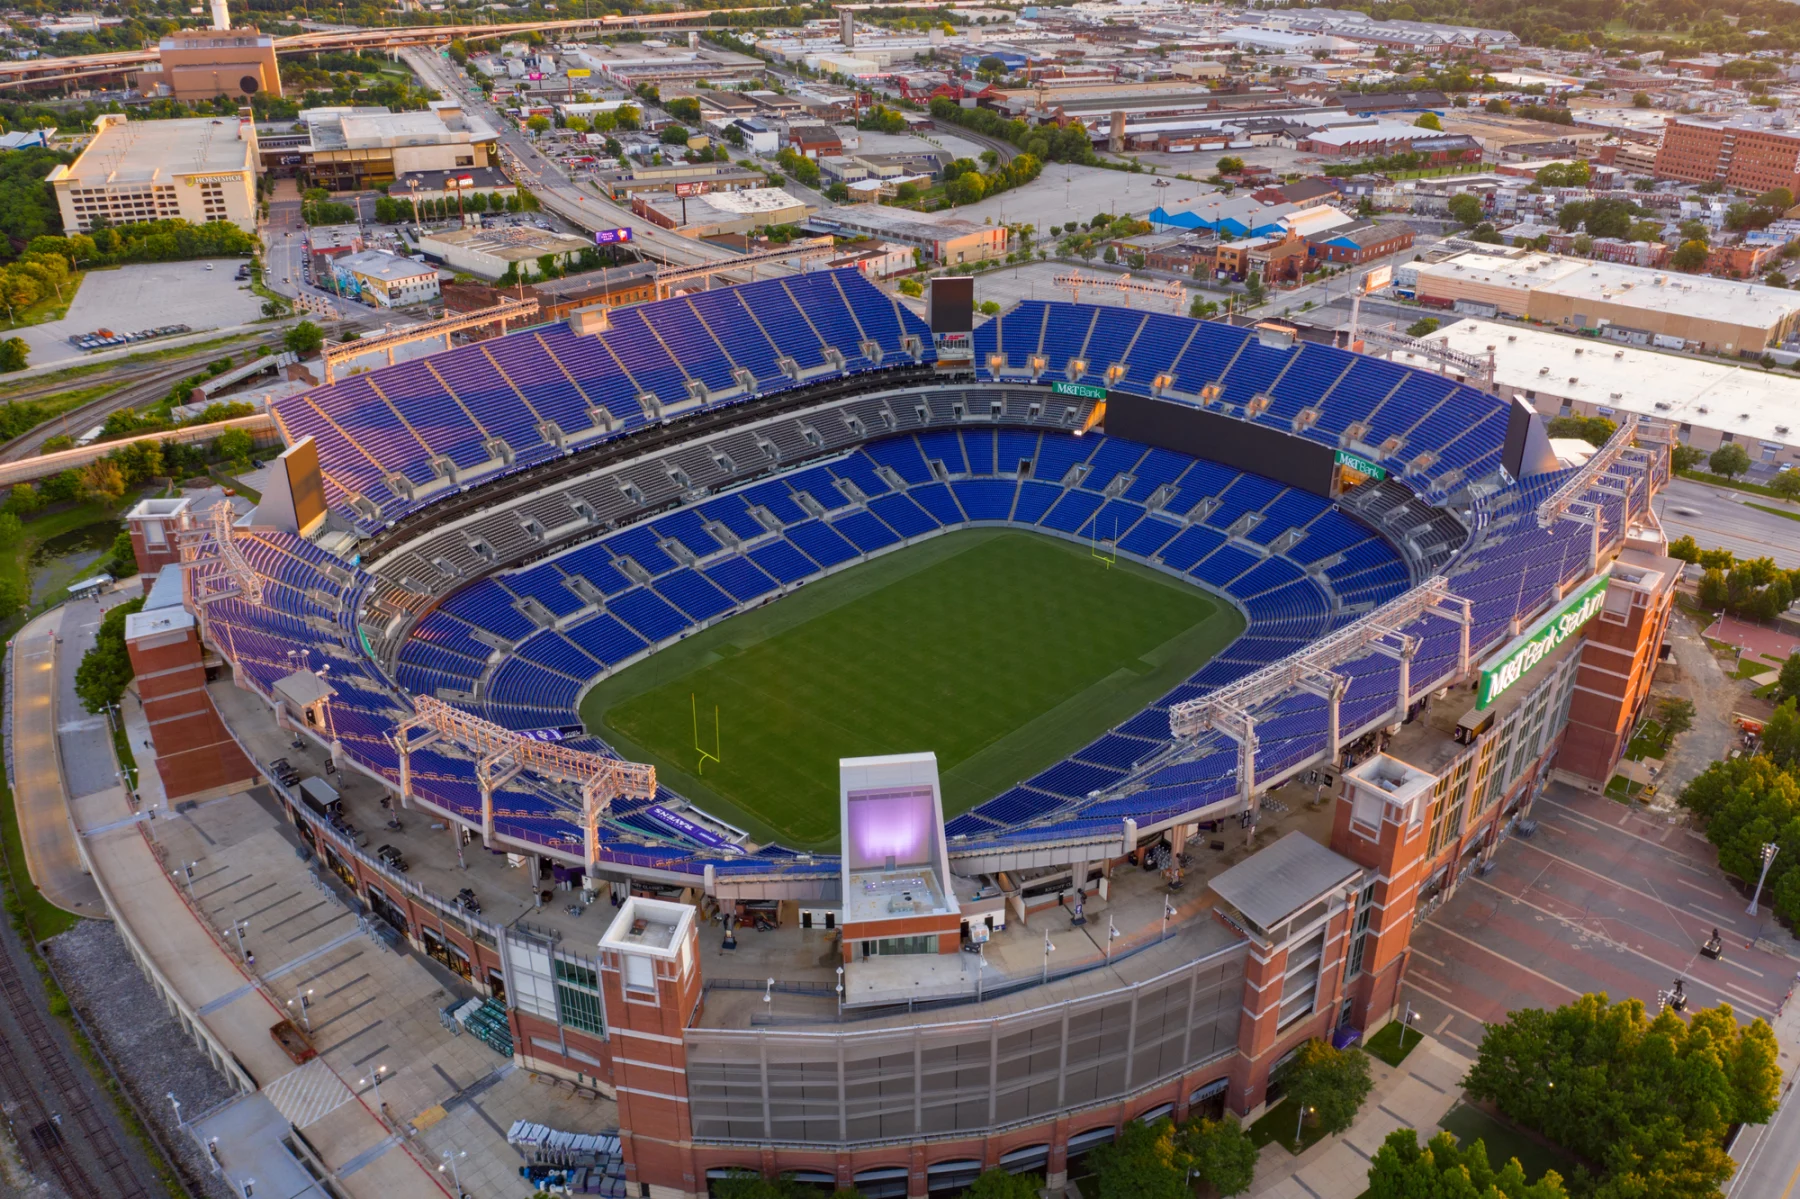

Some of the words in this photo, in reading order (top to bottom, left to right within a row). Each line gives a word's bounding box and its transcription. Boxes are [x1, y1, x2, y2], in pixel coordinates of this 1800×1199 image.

[195, 175, 241, 184] HORSESHOE
[1057, 383, 1080, 396] M&T
[1080, 386, 1101, 399] Bank
[1340, 452, 1360, 470] M&T
[1359, 461, 1379, 479] Bank
[1486, 648, 1528, 703] M&T
[1523, 625, 1557, 672] Bank
[1556, 588, 1606, 643] Stadium
[654, 803, 694, 831] RAVENS
